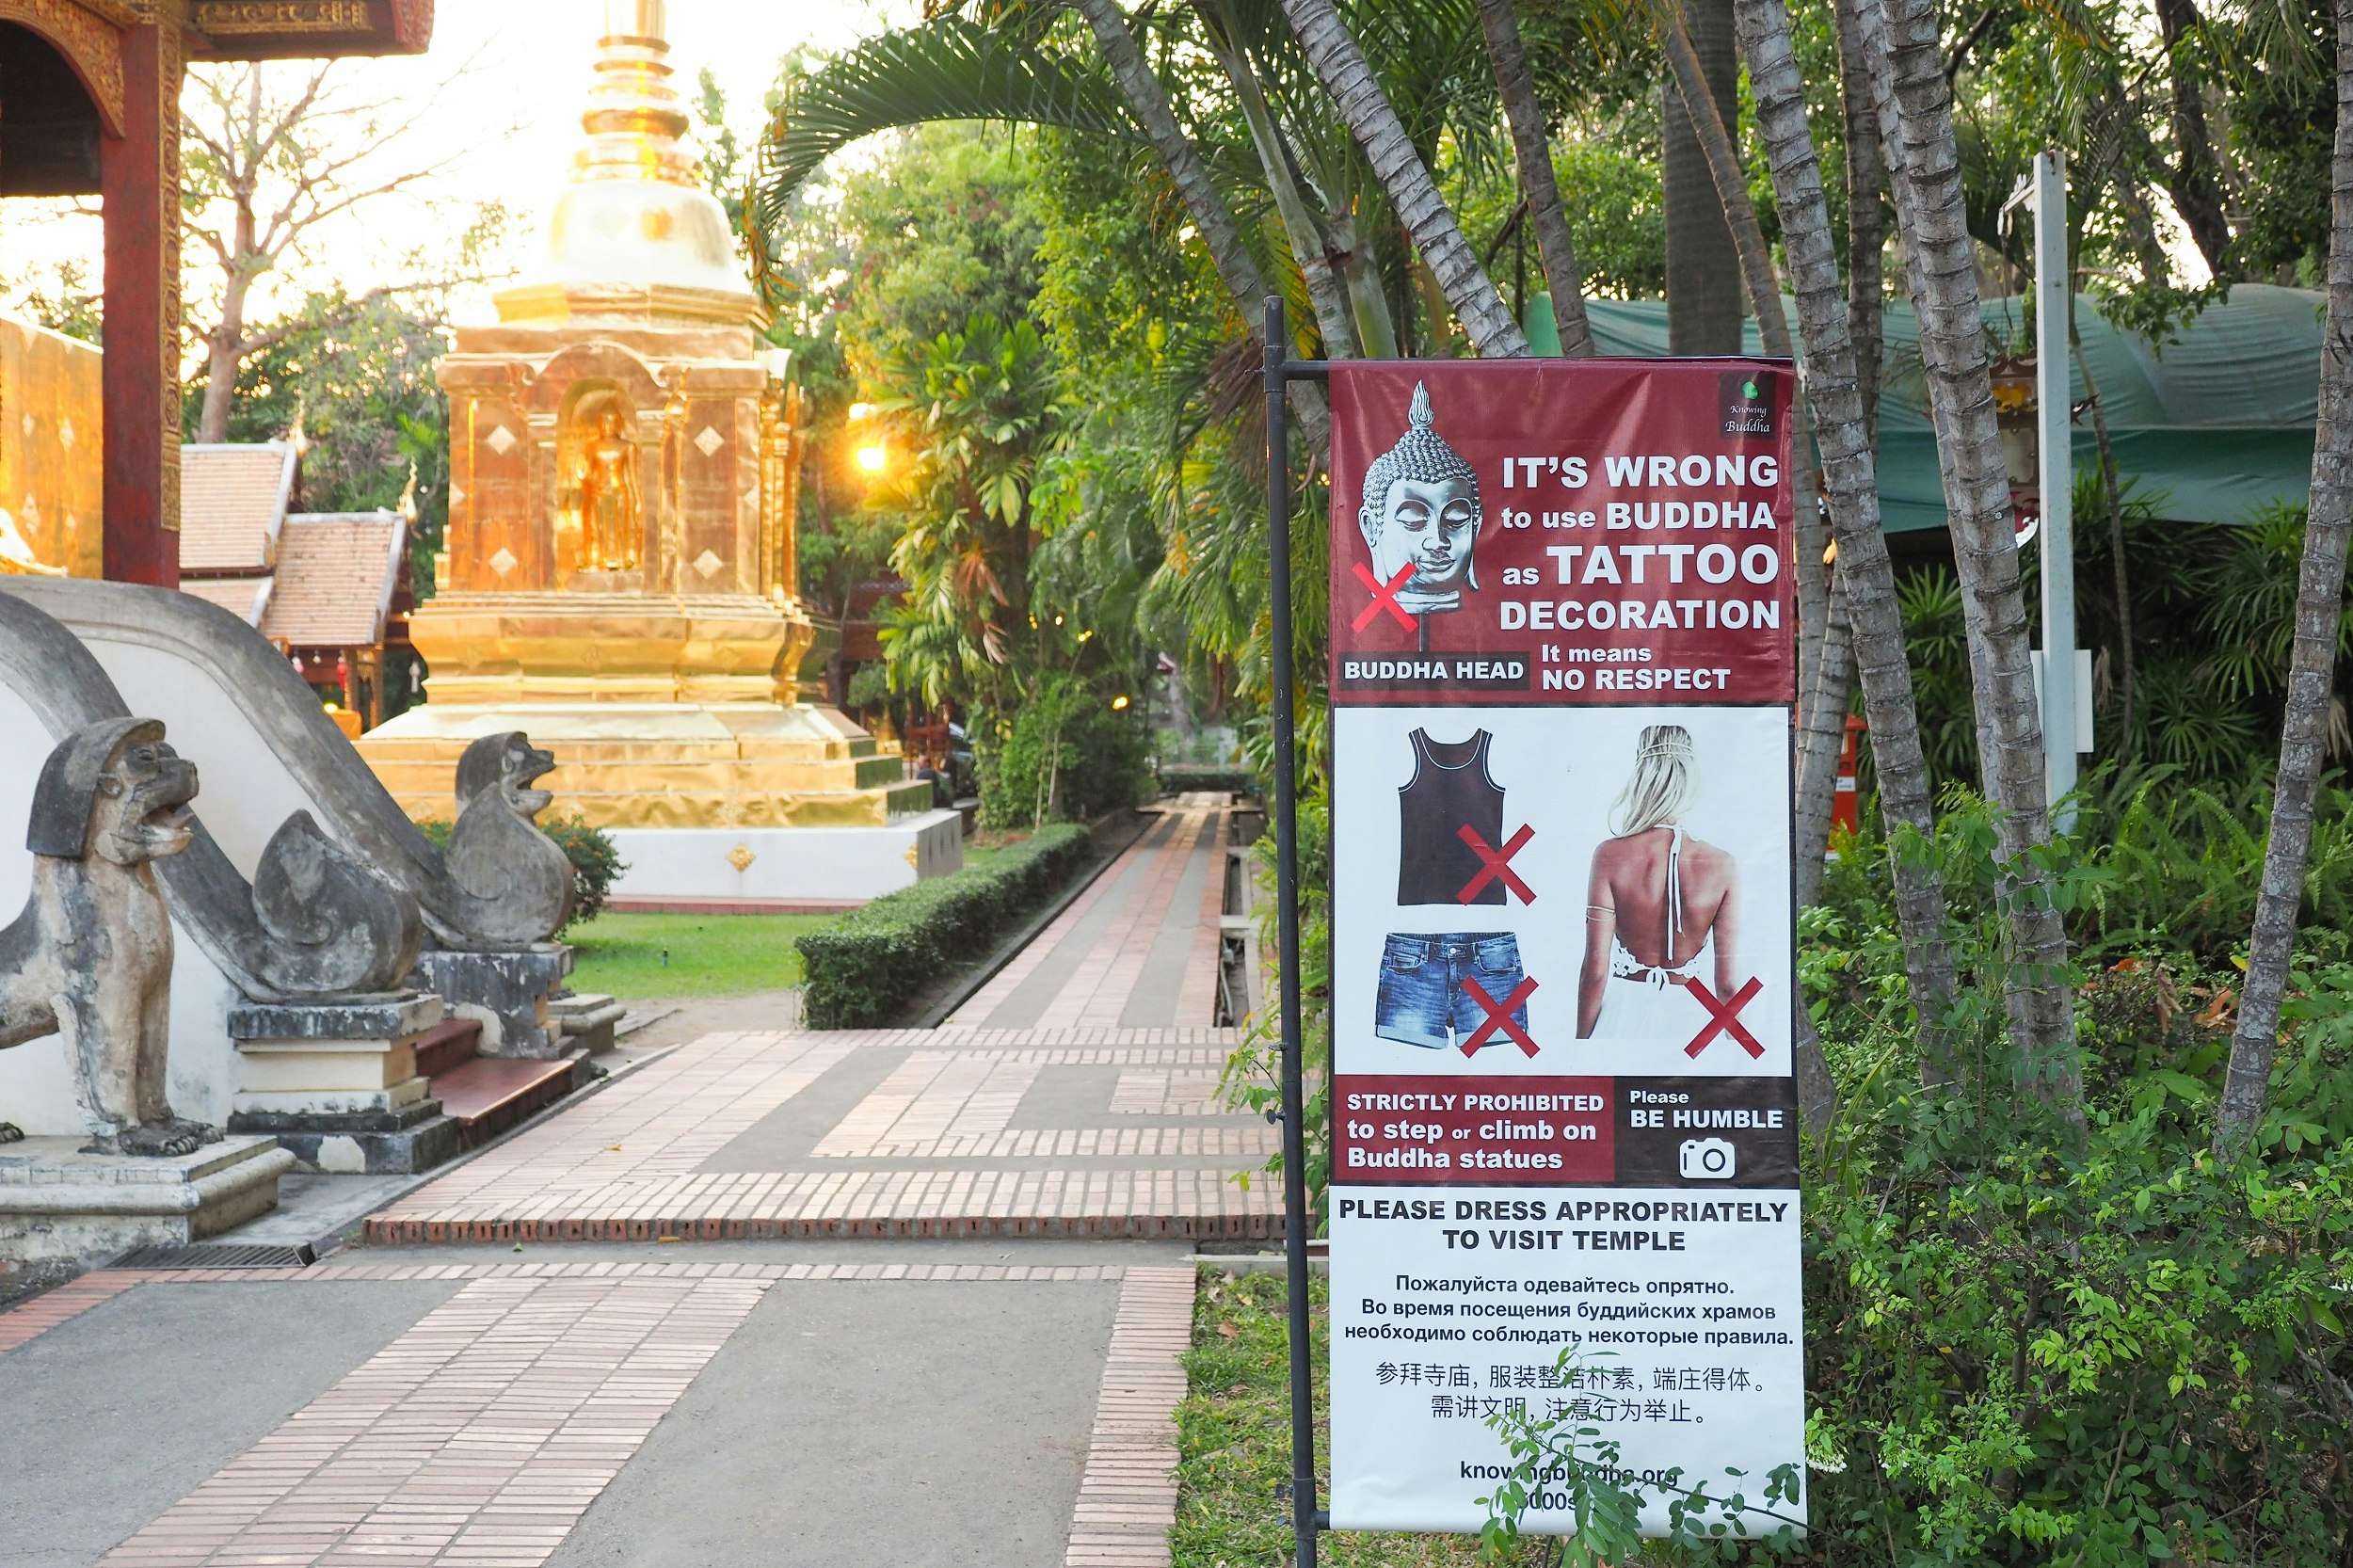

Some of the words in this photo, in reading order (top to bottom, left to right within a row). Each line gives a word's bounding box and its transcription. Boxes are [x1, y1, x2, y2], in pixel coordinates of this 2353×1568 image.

[1729, 404, 1768, 418] Knowing
[1724, 419, 1769, 433] Buddha
[1504, 457, 1588, 488] IT'S
[1604, 456, 1777, 487] WRONG
[1501, 507, 1531, 528] to
[1543, 512, 1595, 528] use
[1608, 502, 1776, 529] BUDDHA
[1503, 568, 1539, 584] as
[1546, 544, 1778, 584] TATTOO
[1501, 600, 1779, 630] DECORATION
[1543, 645, 1560, 662] It
[1569, 648, 1651, 662] means
[1345, 662, 1448, 679] BUDDHA
[1457, 662, 1523, 679] HEAD
[1544, 669, 1584, 690] NO
[1596, 669, 1730, 689] RESPECT
[1348, 1094, 1457, 1110] STRICTLY
[1465, 1095, 1603, 1111] PROHIBITED
[1631, 1091, 1689, 1103] Please
[1631, 1110, 1664, 1128] BE
[1673, 1111, 1783, 1128] HUMBLE
[1348, 1119, 1374, 1138] to
[1384, 1120, 1443, 1144] step
[1452, 1129, 1471, 1139] or
[1480, 1120, 1554, 1140] climb
[1563, 1126, 1595, 1140] on
[1349, 1147, 1449, 1167] Buddha
[1460, 1149, 1562, 1168] statues
[1340, 1200, 1445, 1220] PLEASE
[1456, 1201, 1545, 1220] DRESS
[1556, 1202, 1788, 1222] APPROPRIATELY
[1443, 1230, 1479, 1249] TO
[1489, 1230, 1562, 1249] VISIT
[1573, 1231, 1685, 1250] TEMPLE
[1397, 1275, 1516, 1294] Пожалуйста
[1524, 1277, 1640, 1294] одевайтесь
[1647, 1282, 1734, 1297] опрятно.
[1363, 1299, 1386, 1314] Во
[1394, 1304, 1453, 1318] время
[1461, 1305, 1570, 1320] посещения
[1578, 1302, 1696, 1320] буддийских
[1703, 1307, 1775, 1322] храмов
[1346, 1323, 1465, 1342] необходимо
[1473, 1326, 1581, 1344] соблюдать
[1589, 1331, 1698, 1347] некоторые
[1705, 1333, 1793, 1347] правила.
